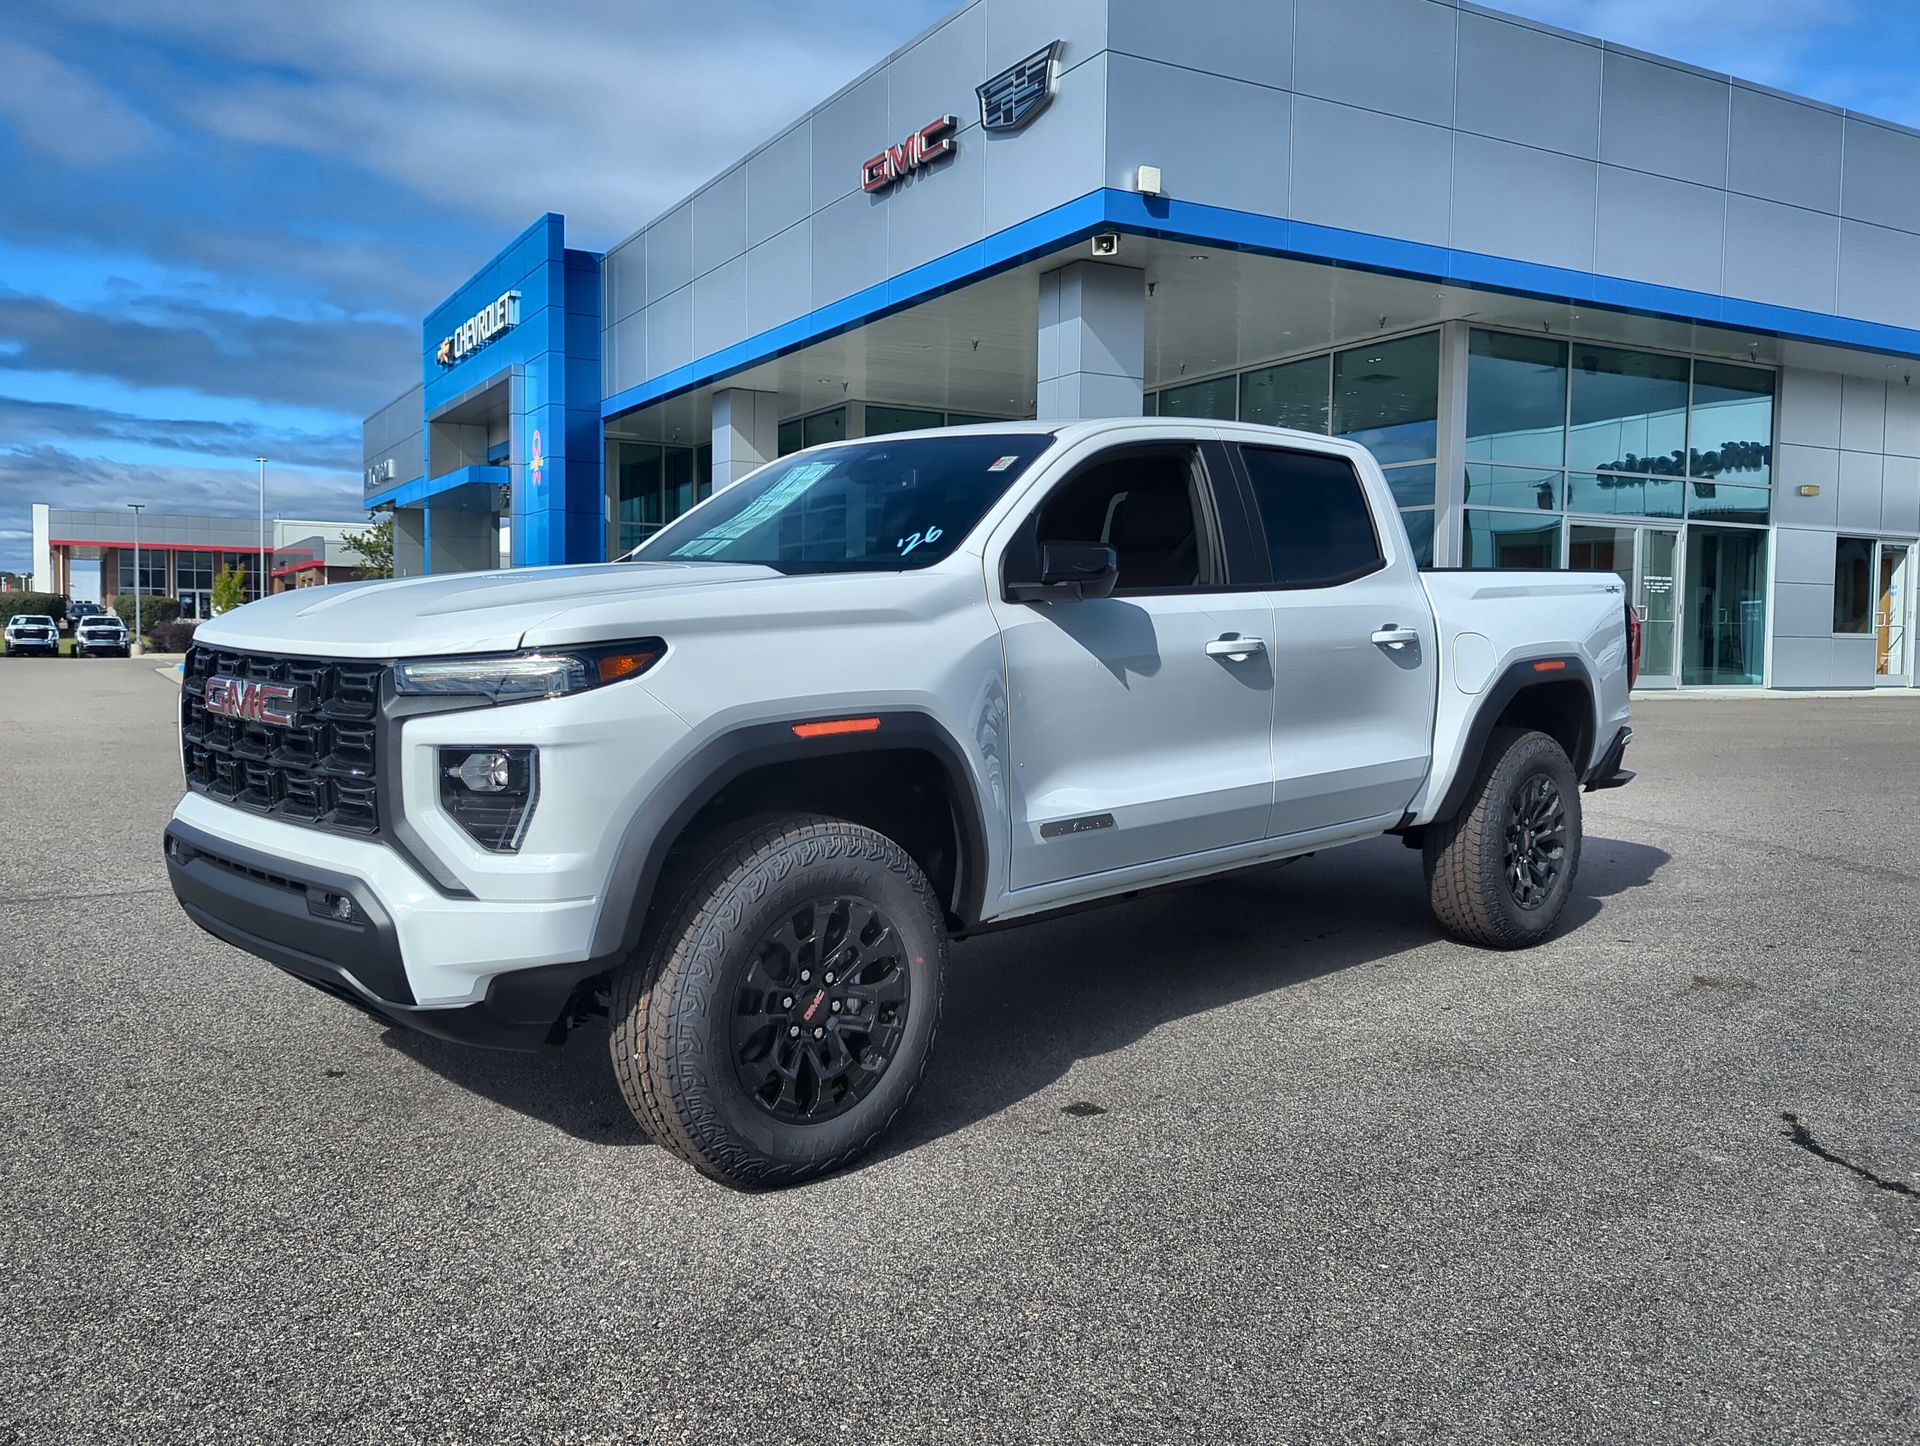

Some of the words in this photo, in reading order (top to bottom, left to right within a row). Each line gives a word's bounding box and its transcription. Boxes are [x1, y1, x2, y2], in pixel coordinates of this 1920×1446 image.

[861, 114, 957, 194] GMC
[454, 290, 522, 358] CHEVROLET
[896, 525, 943, 556] '26
[205, 675, 298, 728] GMC
